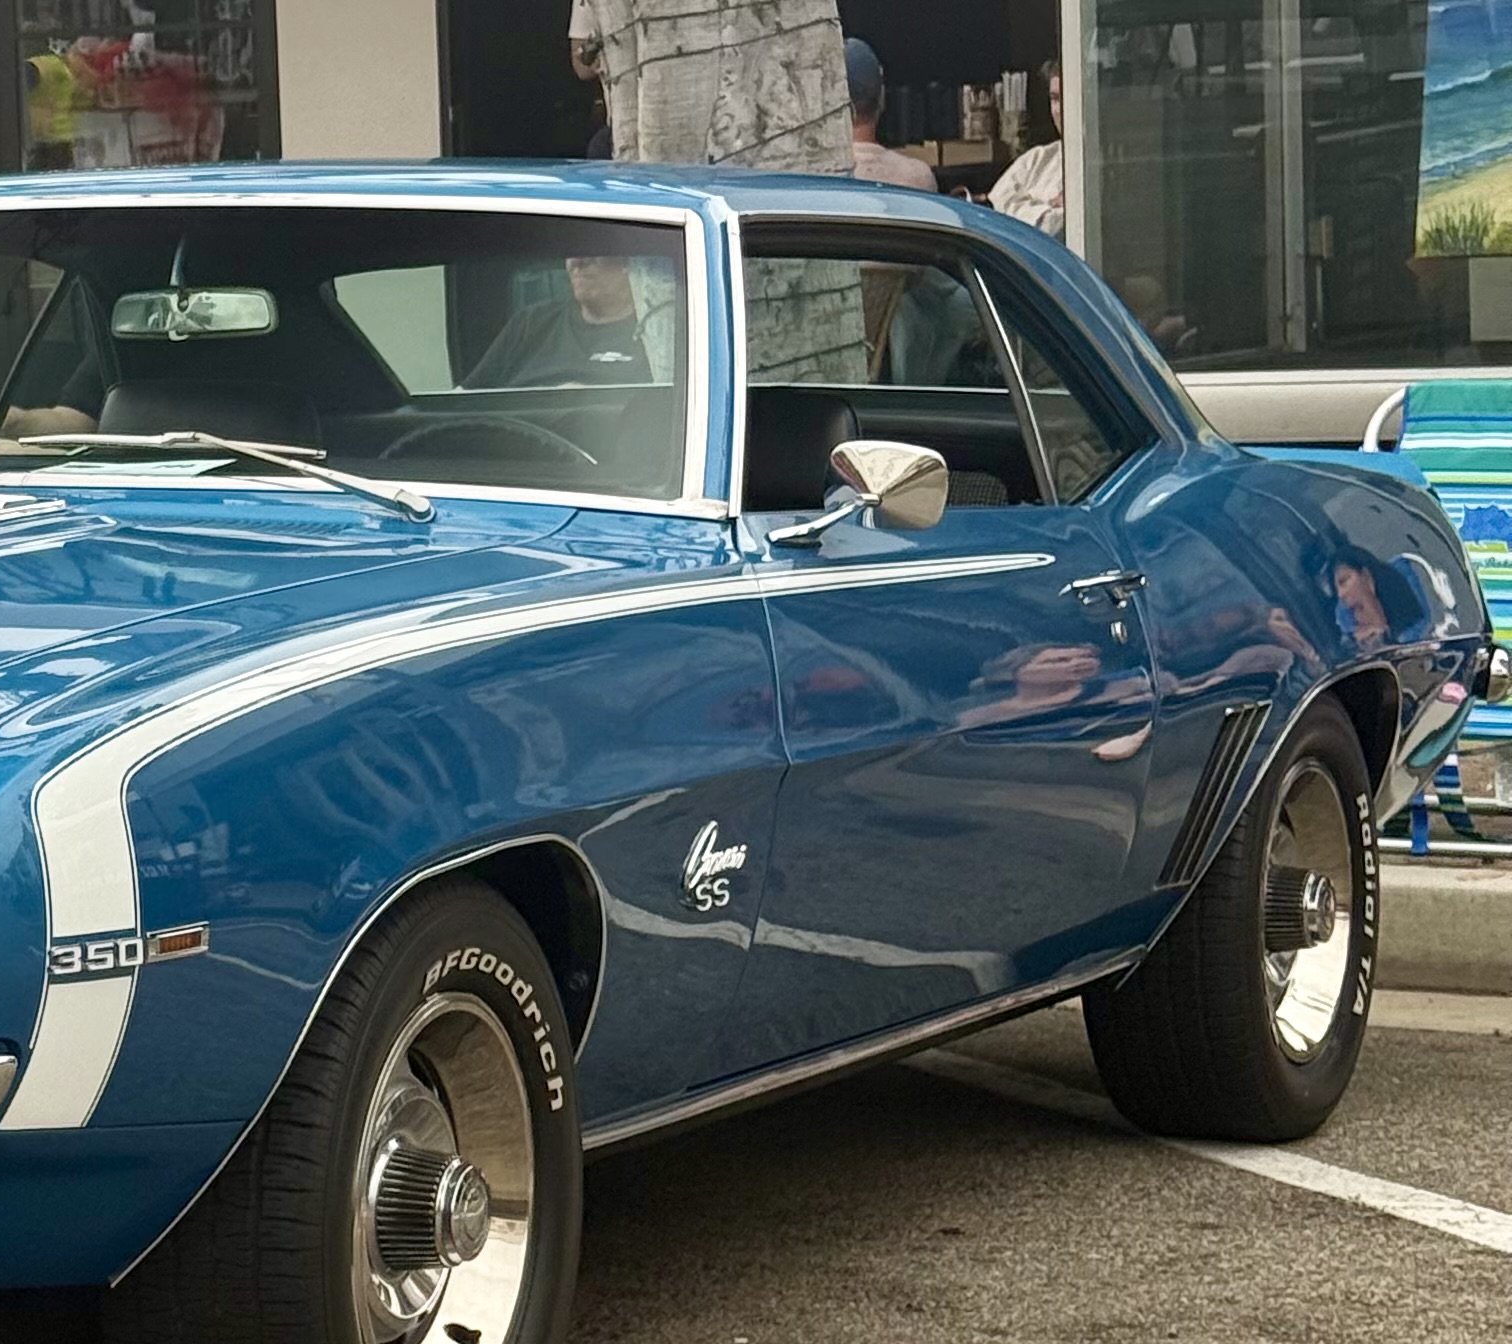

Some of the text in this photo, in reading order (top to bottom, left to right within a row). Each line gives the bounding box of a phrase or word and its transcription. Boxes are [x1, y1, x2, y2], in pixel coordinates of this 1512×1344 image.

[695, 878, 730, 911] SS
[1355, 793, 1376, 939] Radial
[49, 938, 144, 975] 350
[422, 947, 564, 1111] BFGoodrich
